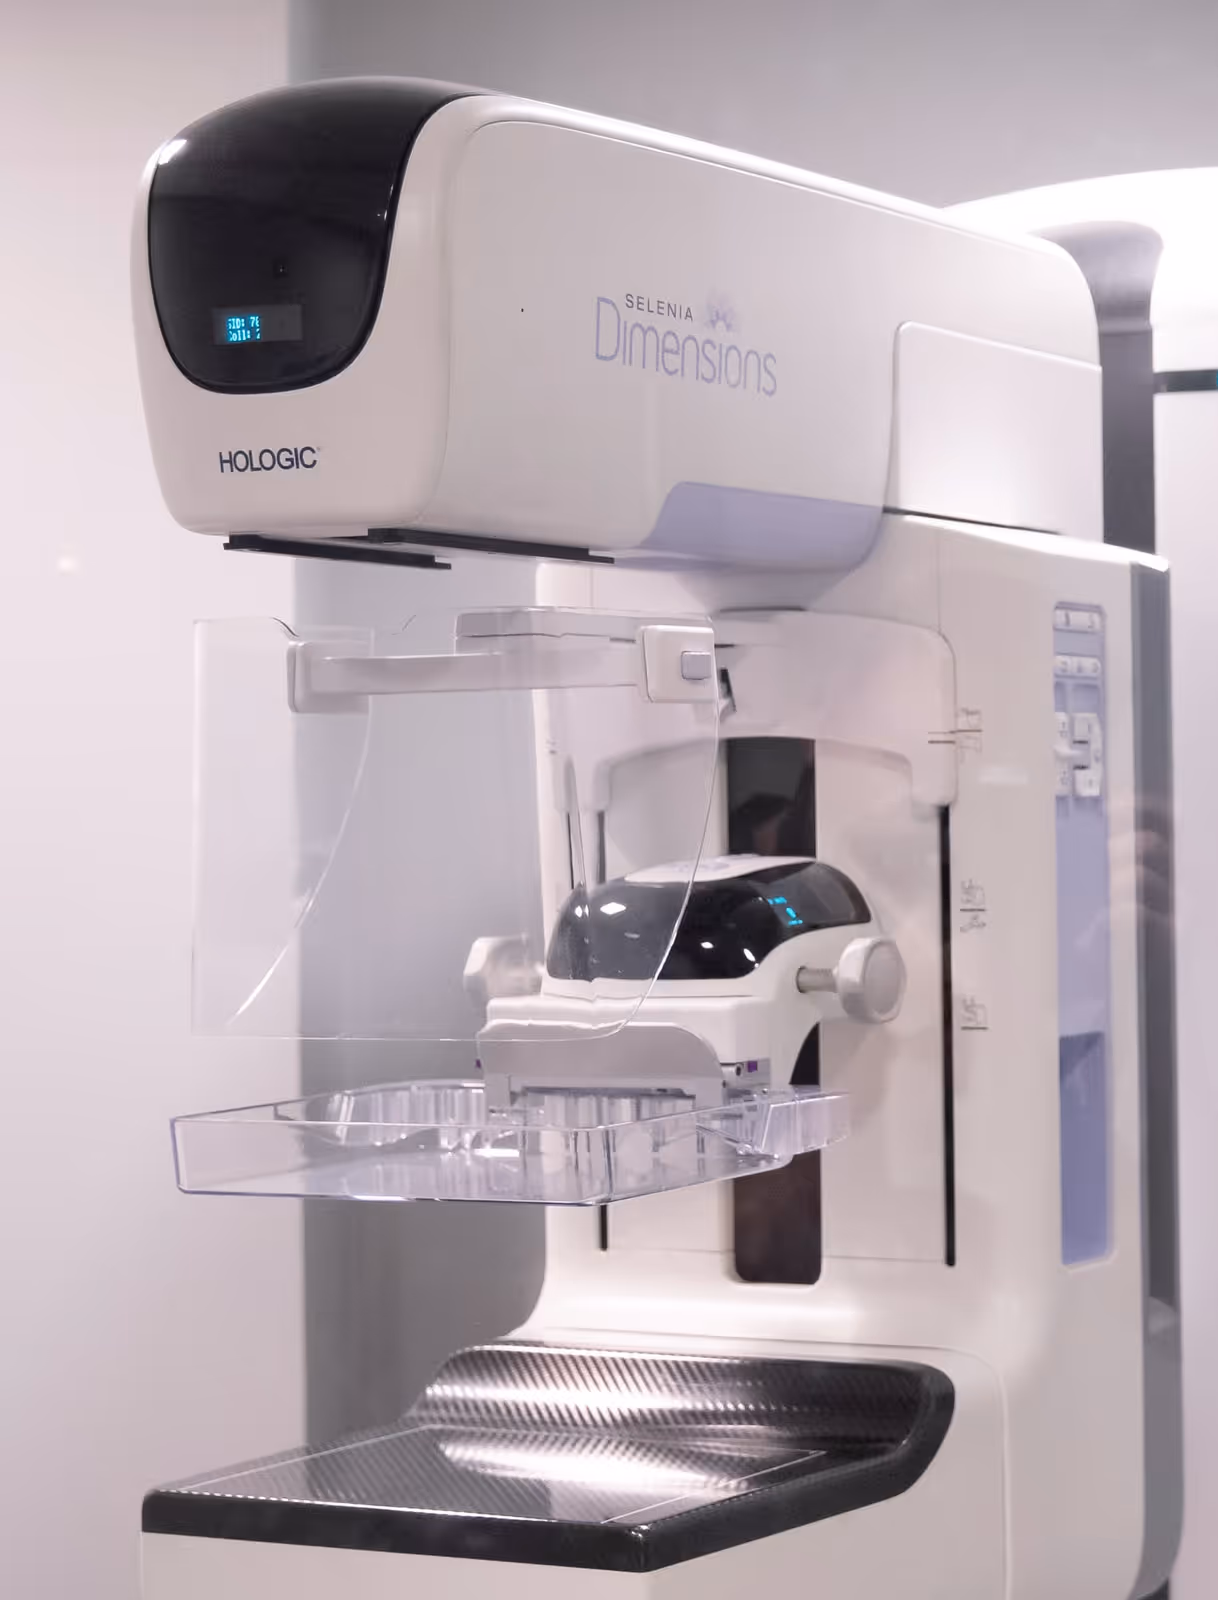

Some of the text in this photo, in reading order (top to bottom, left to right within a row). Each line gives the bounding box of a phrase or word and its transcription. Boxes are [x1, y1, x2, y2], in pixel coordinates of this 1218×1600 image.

[625, 293, 694, 322] SELENIA
[595, 296, 777, 396] Dimensions
[218, 446, 317, 473] HOLOGIC
